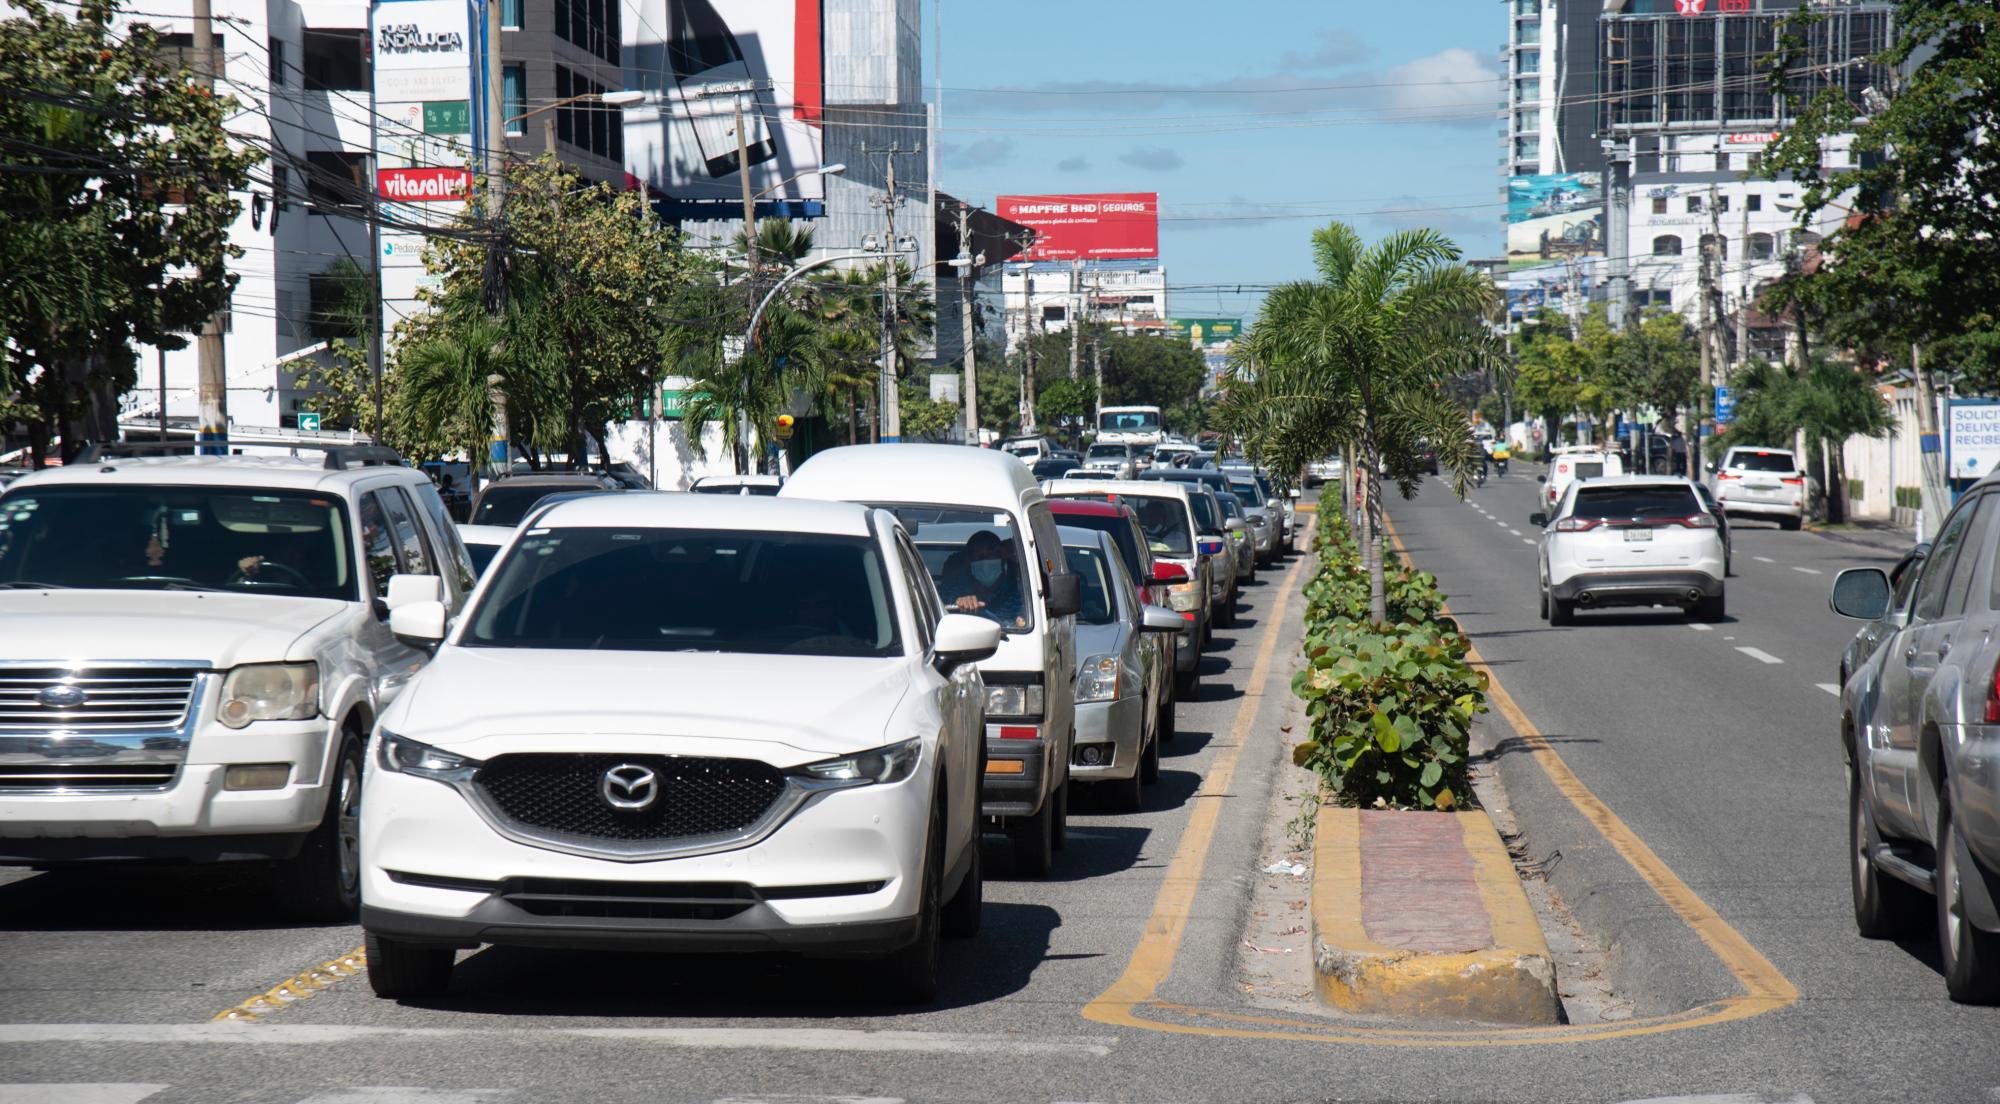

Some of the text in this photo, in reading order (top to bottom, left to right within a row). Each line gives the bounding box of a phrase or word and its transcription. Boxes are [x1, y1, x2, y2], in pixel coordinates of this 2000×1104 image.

[385, 173, 467, 197] vitasalud
[1018, 202, 1145, 214] MAPFRE BHD SEGUROS
